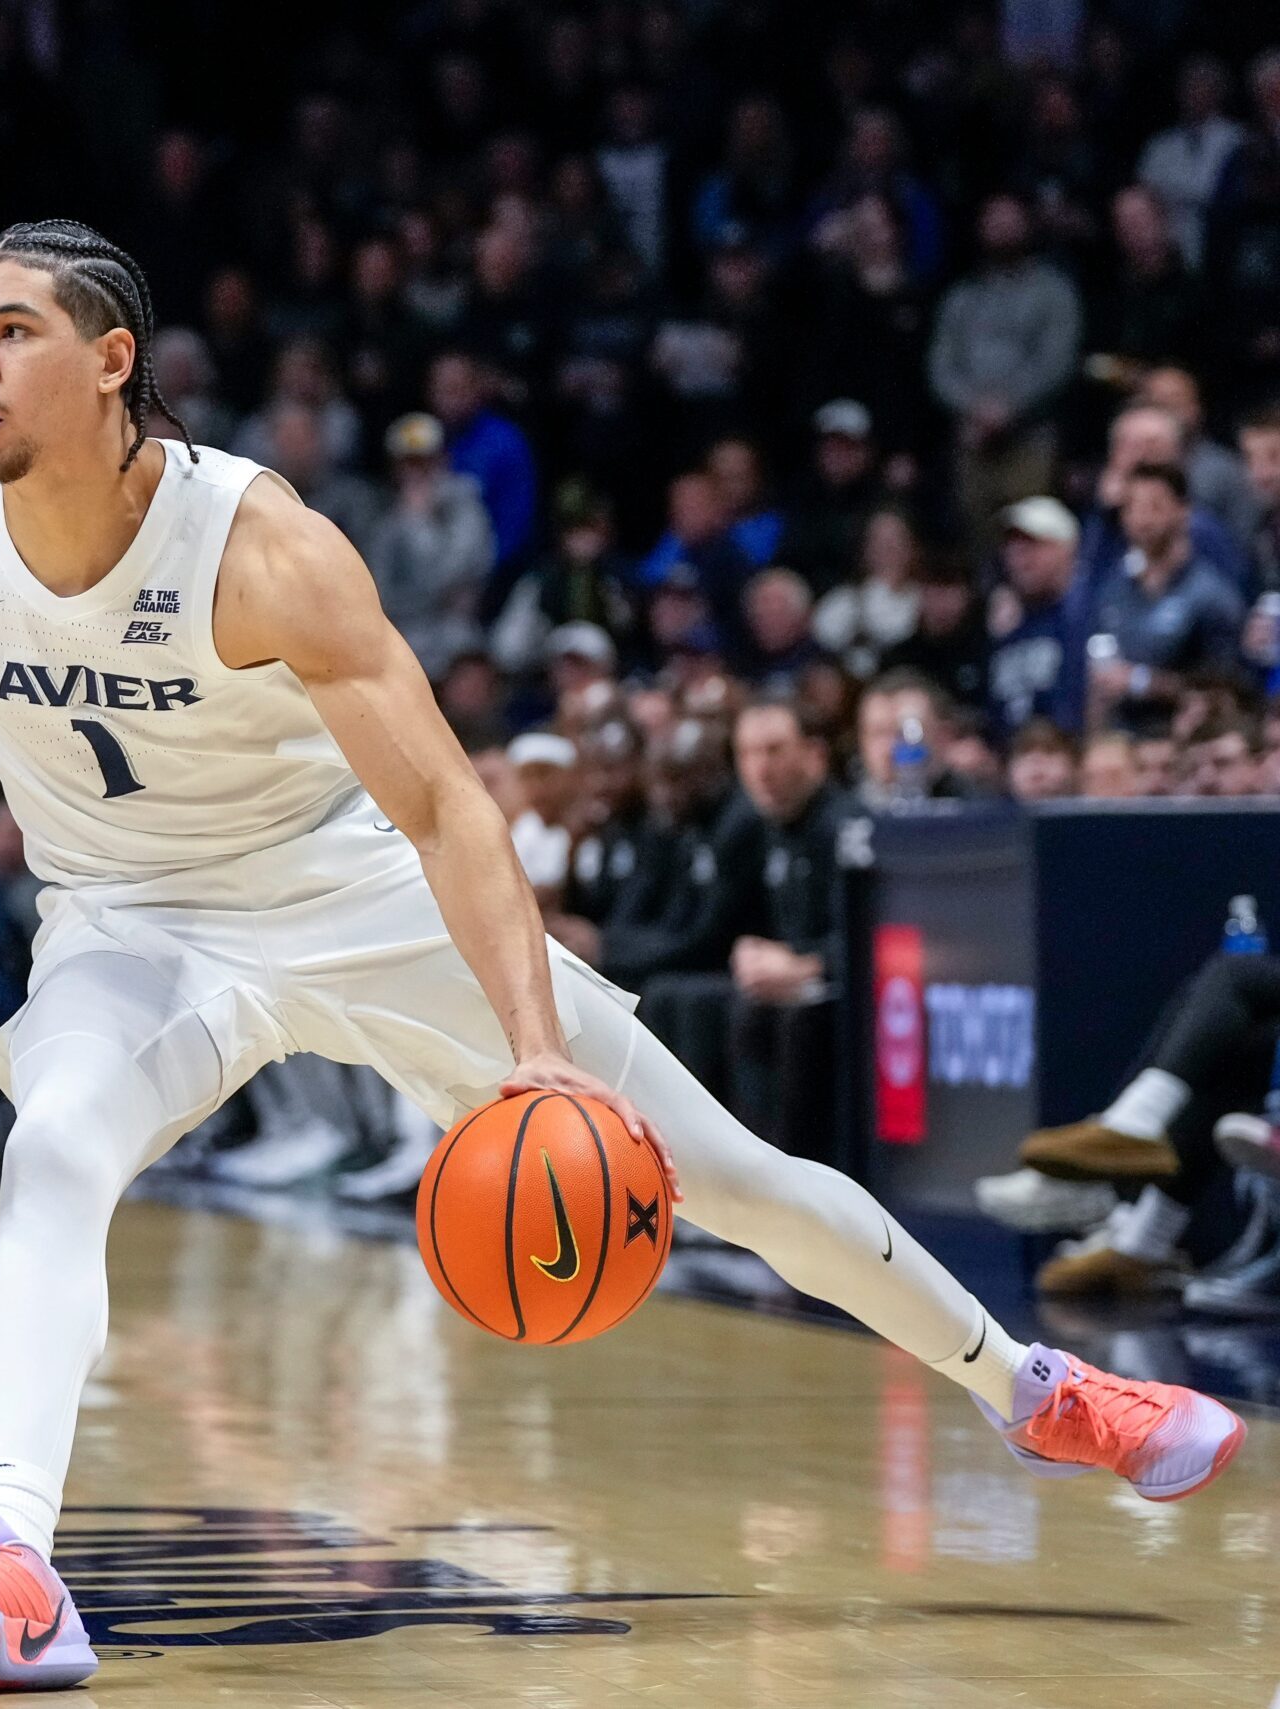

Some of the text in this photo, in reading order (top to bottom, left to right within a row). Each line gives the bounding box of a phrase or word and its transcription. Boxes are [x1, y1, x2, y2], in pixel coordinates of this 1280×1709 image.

[138, 589, 180, 602] BE THE
[133, 600, 181, 614] CHANGE
[128, 620, 163, 631] BIG
[123, 630, 173, 642] EAST
[70, 718, 147, 799] 1
